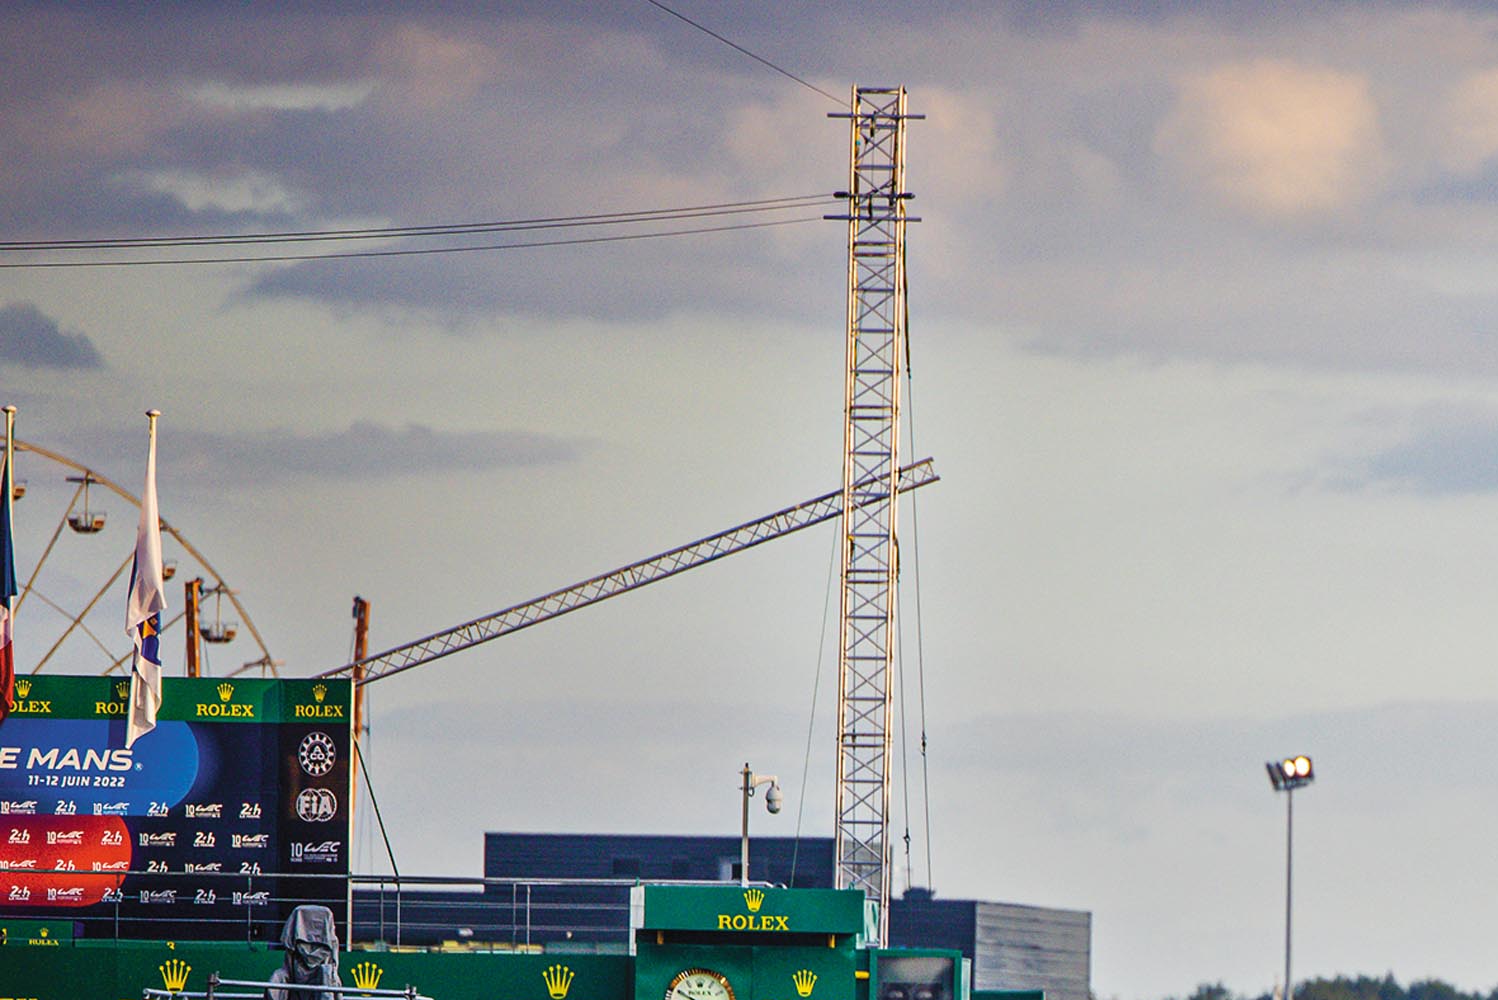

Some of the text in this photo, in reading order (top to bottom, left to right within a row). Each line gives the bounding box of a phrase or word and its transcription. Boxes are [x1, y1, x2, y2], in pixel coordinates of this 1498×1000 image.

[9, 700, 52, 713] OLEX
[95, 702, 128, 714] ROL
[196, 703, 254, 717] ROLEX
[295, 704, 343, 717] ROLEX
[26, 747, 134, 771] MANS
[28, 775, 126, 788] 11-12 JUIN 2022
[290, 842, 303, 857] 10
[717, 914, 790, 931] ROLEX
